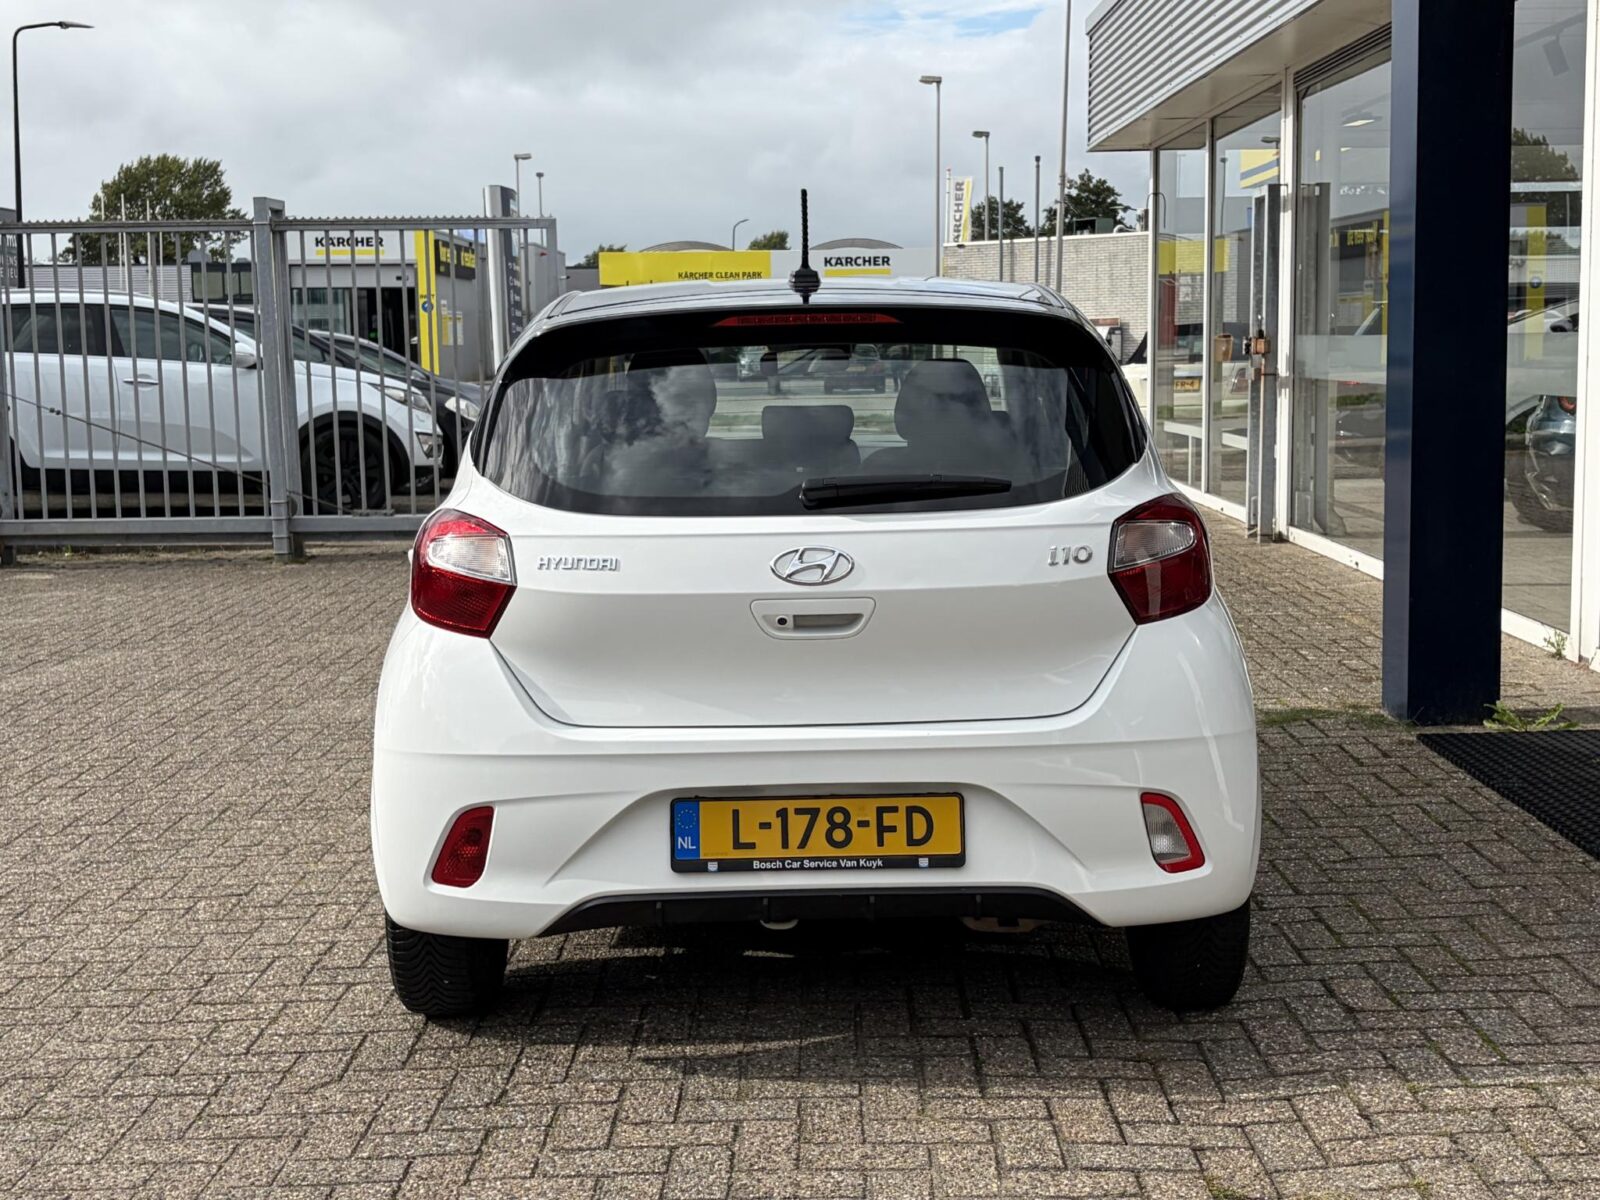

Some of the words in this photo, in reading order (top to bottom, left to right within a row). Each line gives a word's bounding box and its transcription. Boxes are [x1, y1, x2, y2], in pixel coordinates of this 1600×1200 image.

[823, 255, 891, 267] KÄRCHER
[678, 270, 714, 280] KÄRCHER
[715, 271, 740, 279] CLEAN
[741, 271, 763, 279] PARK
[1048, 545, 1093, 567] i10
[537, 555, 620, 572] HYUNDAI
[732, 805, 934, 850] L-178-FD
[677, 836, 697, 850] NL
[753, 860, 782, 870] Bosch
[784, 860, 801, 869] Car
[803, 859, 838, 869] Service
[840, 859, 858, 868] Van
[859, 858, 883, 870] Kuyk
